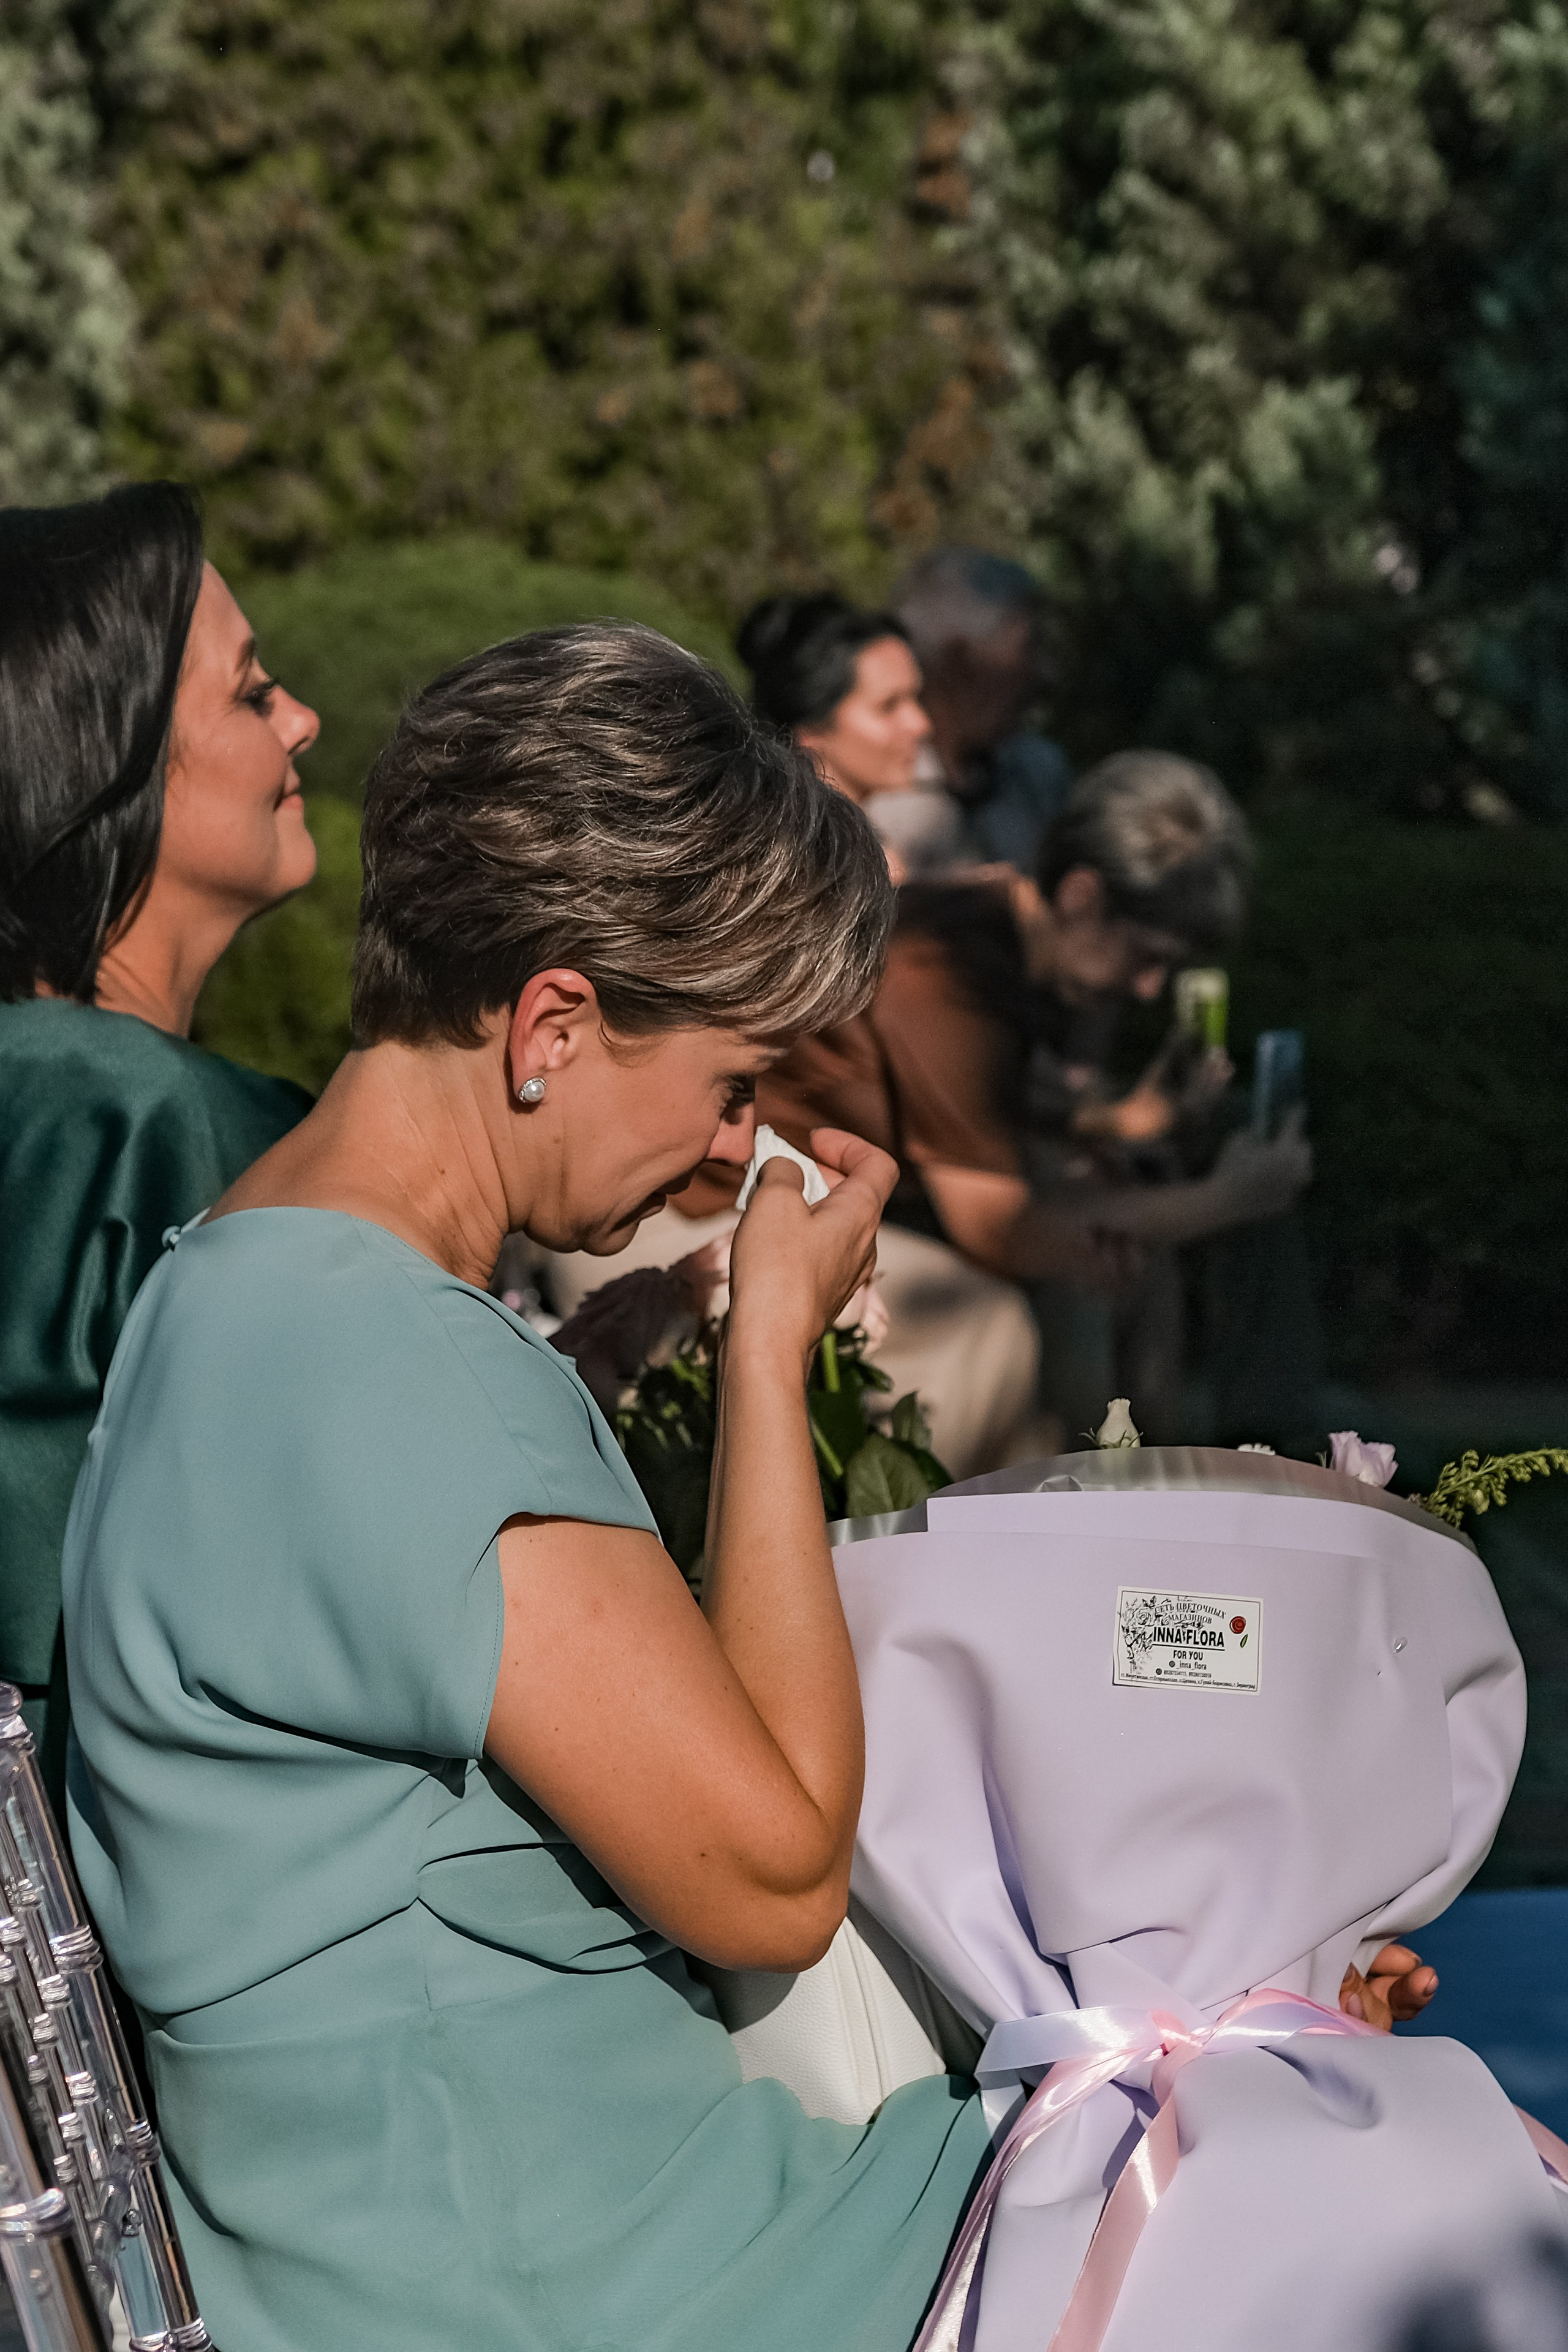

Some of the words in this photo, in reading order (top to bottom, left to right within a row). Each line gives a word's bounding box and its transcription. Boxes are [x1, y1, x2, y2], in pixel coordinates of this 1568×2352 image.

[1155, 1604, 1174, 1613] СЕТЬ
[1177, 1602, 1226, 1619] ЦВЕТОЧНЫХ
[1168, 1613, 1213, 1624] МАГАЗИНОВ
[1153, 1626, 1182, 1643] INNA
[1186, 1629, 1224, 1647] FLORA
[1173, 1649, 1187, 1659] FOR
[1189, 1651, 1204, 1660] YOU
